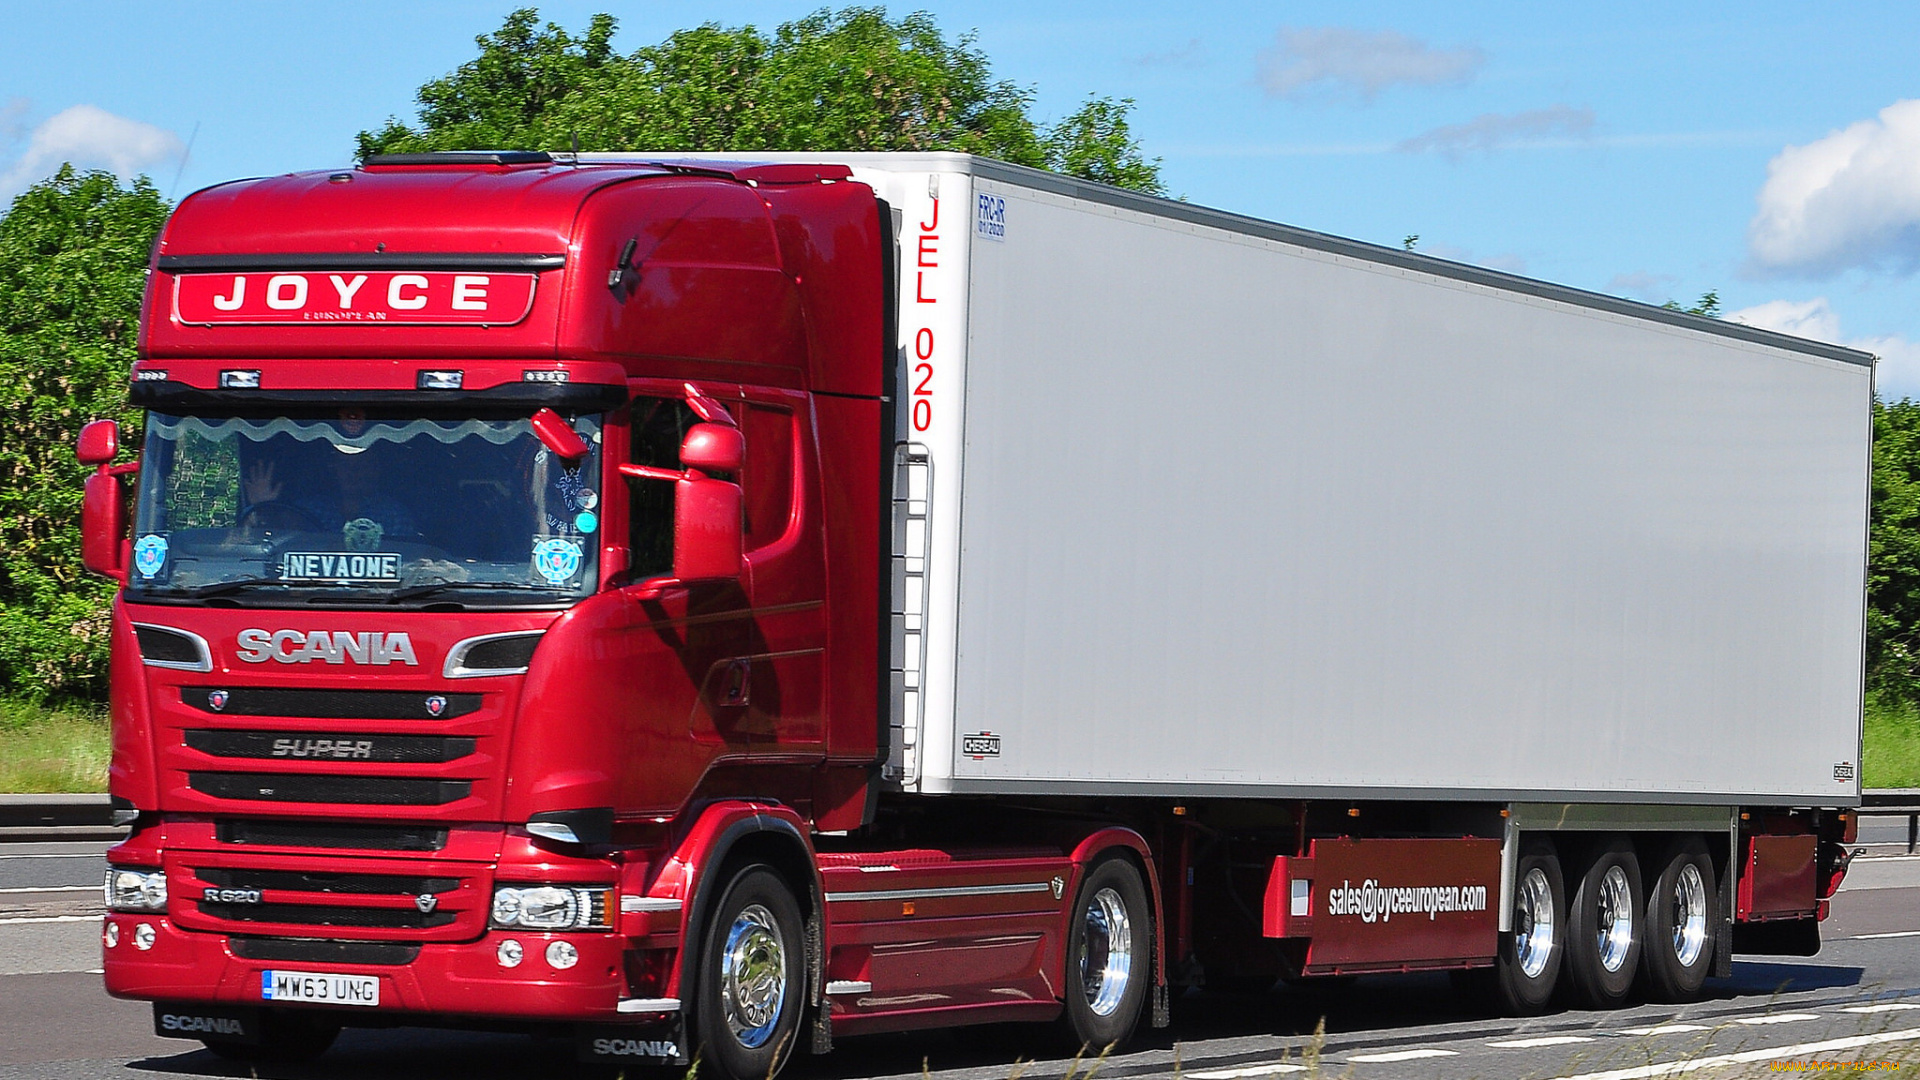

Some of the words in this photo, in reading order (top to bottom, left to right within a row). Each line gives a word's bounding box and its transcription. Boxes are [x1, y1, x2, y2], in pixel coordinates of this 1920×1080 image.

[916, 198, 939, 303] JEL
[213, 275, 488, 311] JOYCE
[303, 311, 387, 320] EUROPEAN
[913, 327, 934, 432] 020
[289, 555, 397, 579] NEVAONE
[236, 628, 419, 666] SCANIA
[271, 739, 373, 759] SUPER
[204, 889, 260, 902] R620
[1328, 878, 1487, 923] sales@joyceeuropean.com
[277, 976, 328, 998] MW63
[336, 979, 373, 1001] UNG
[161, 1013, 245, 1035] SCANIA
[593, 1038, 680, 1057] SCANIA
